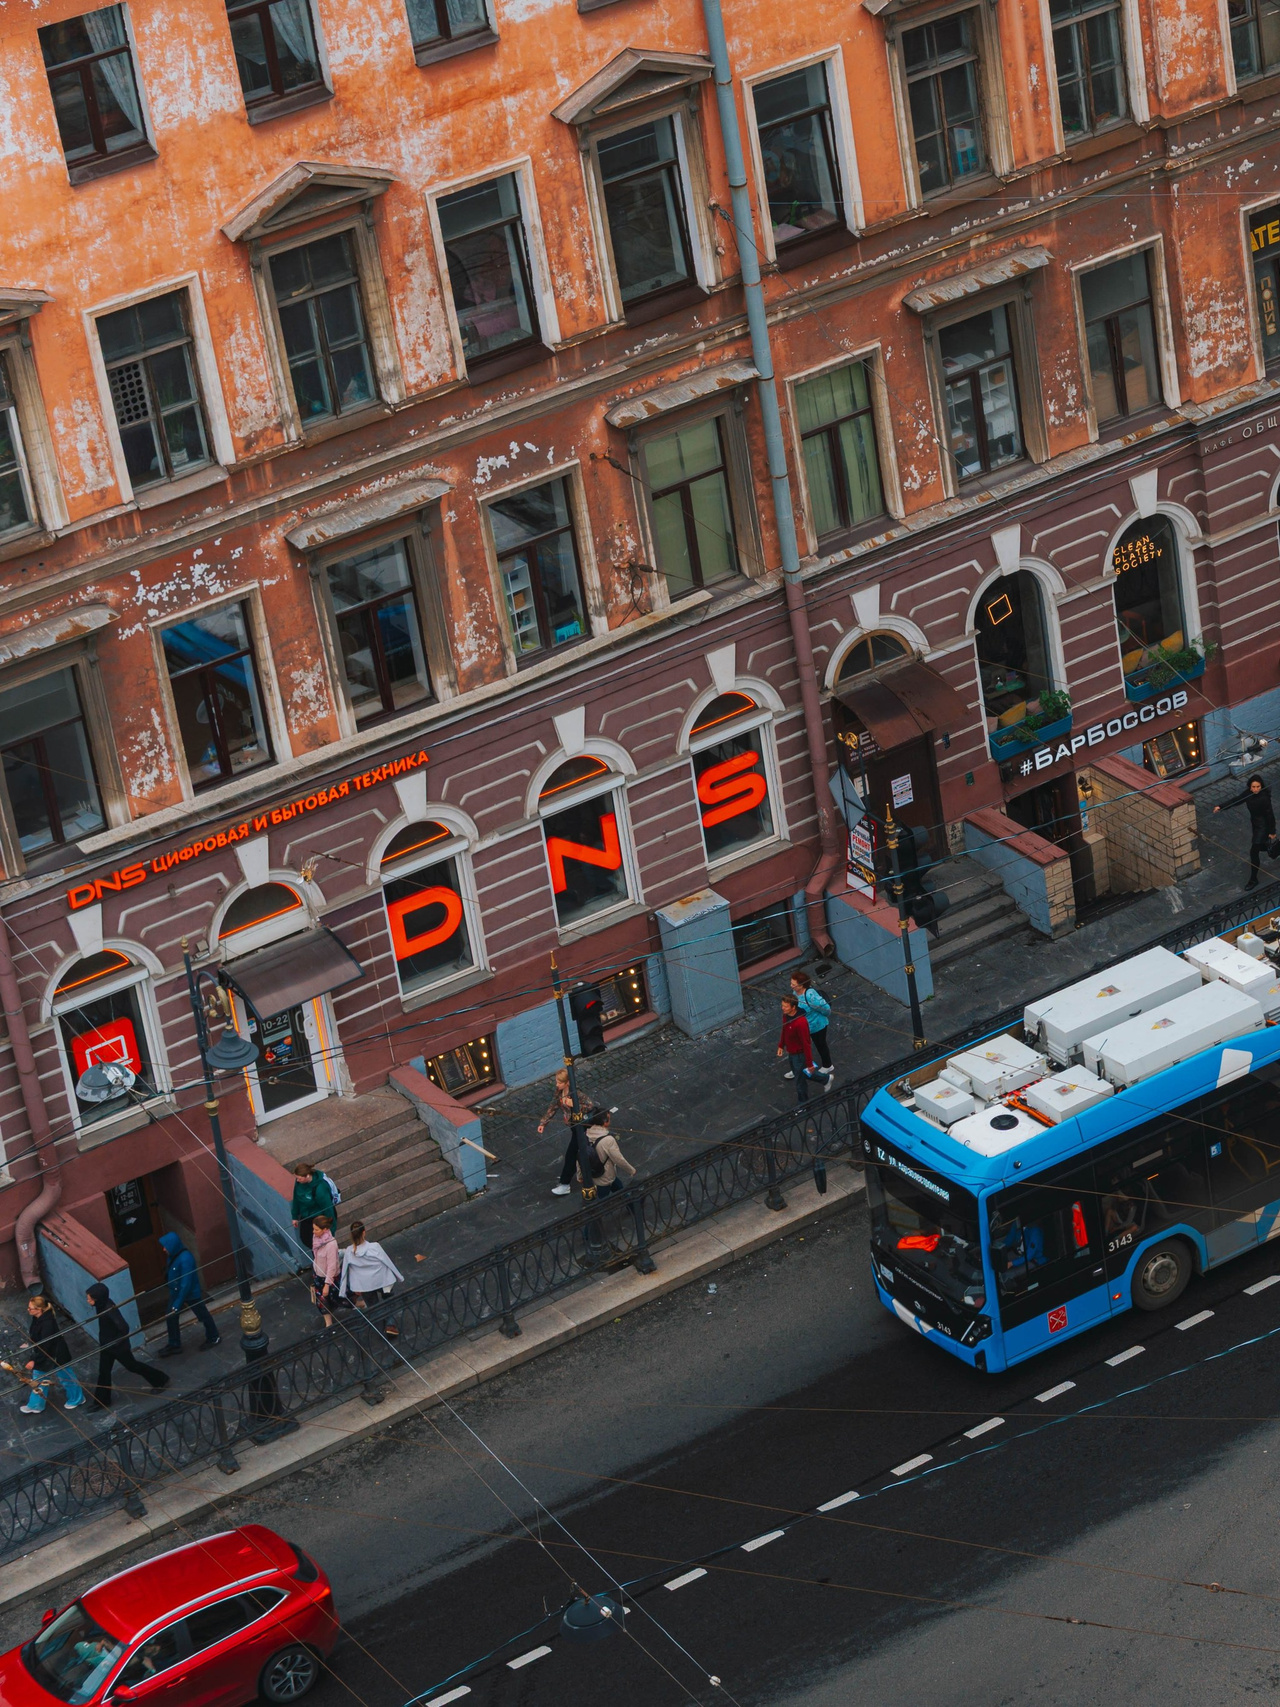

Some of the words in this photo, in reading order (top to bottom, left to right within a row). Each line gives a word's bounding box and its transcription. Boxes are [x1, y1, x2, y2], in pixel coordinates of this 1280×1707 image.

[1260, 275, 1277, 336] ПОШИВ
[1203, 437, 1233, 453] КАФЕ
[1113, 535, 1150, 556] CLEAN
[1115, 542, 1155, 565] PLATES
[1115, 549, 1162, 575] SOCIETY
[1020, 690, 1188, 776] #БАРБОССОВ
[67, 862, 146, 910] DNS
[152, 822, 249, 873] ЦИФРОВАЯ
[254, 817, 268, 833] И
[270, 783, 350, 829] БЫТОВАЯ
[352, 751, 429, 791] ТЕХНИКА
[852, 834, 871, 850] РЕМОНТ
[262, 1014, 288, 1031] 10-22
[877, 1146, 885, 1161] 12
[1108, 1233, 1133, 1252] 3143
[937, 1321, 951, 1335] 3143
